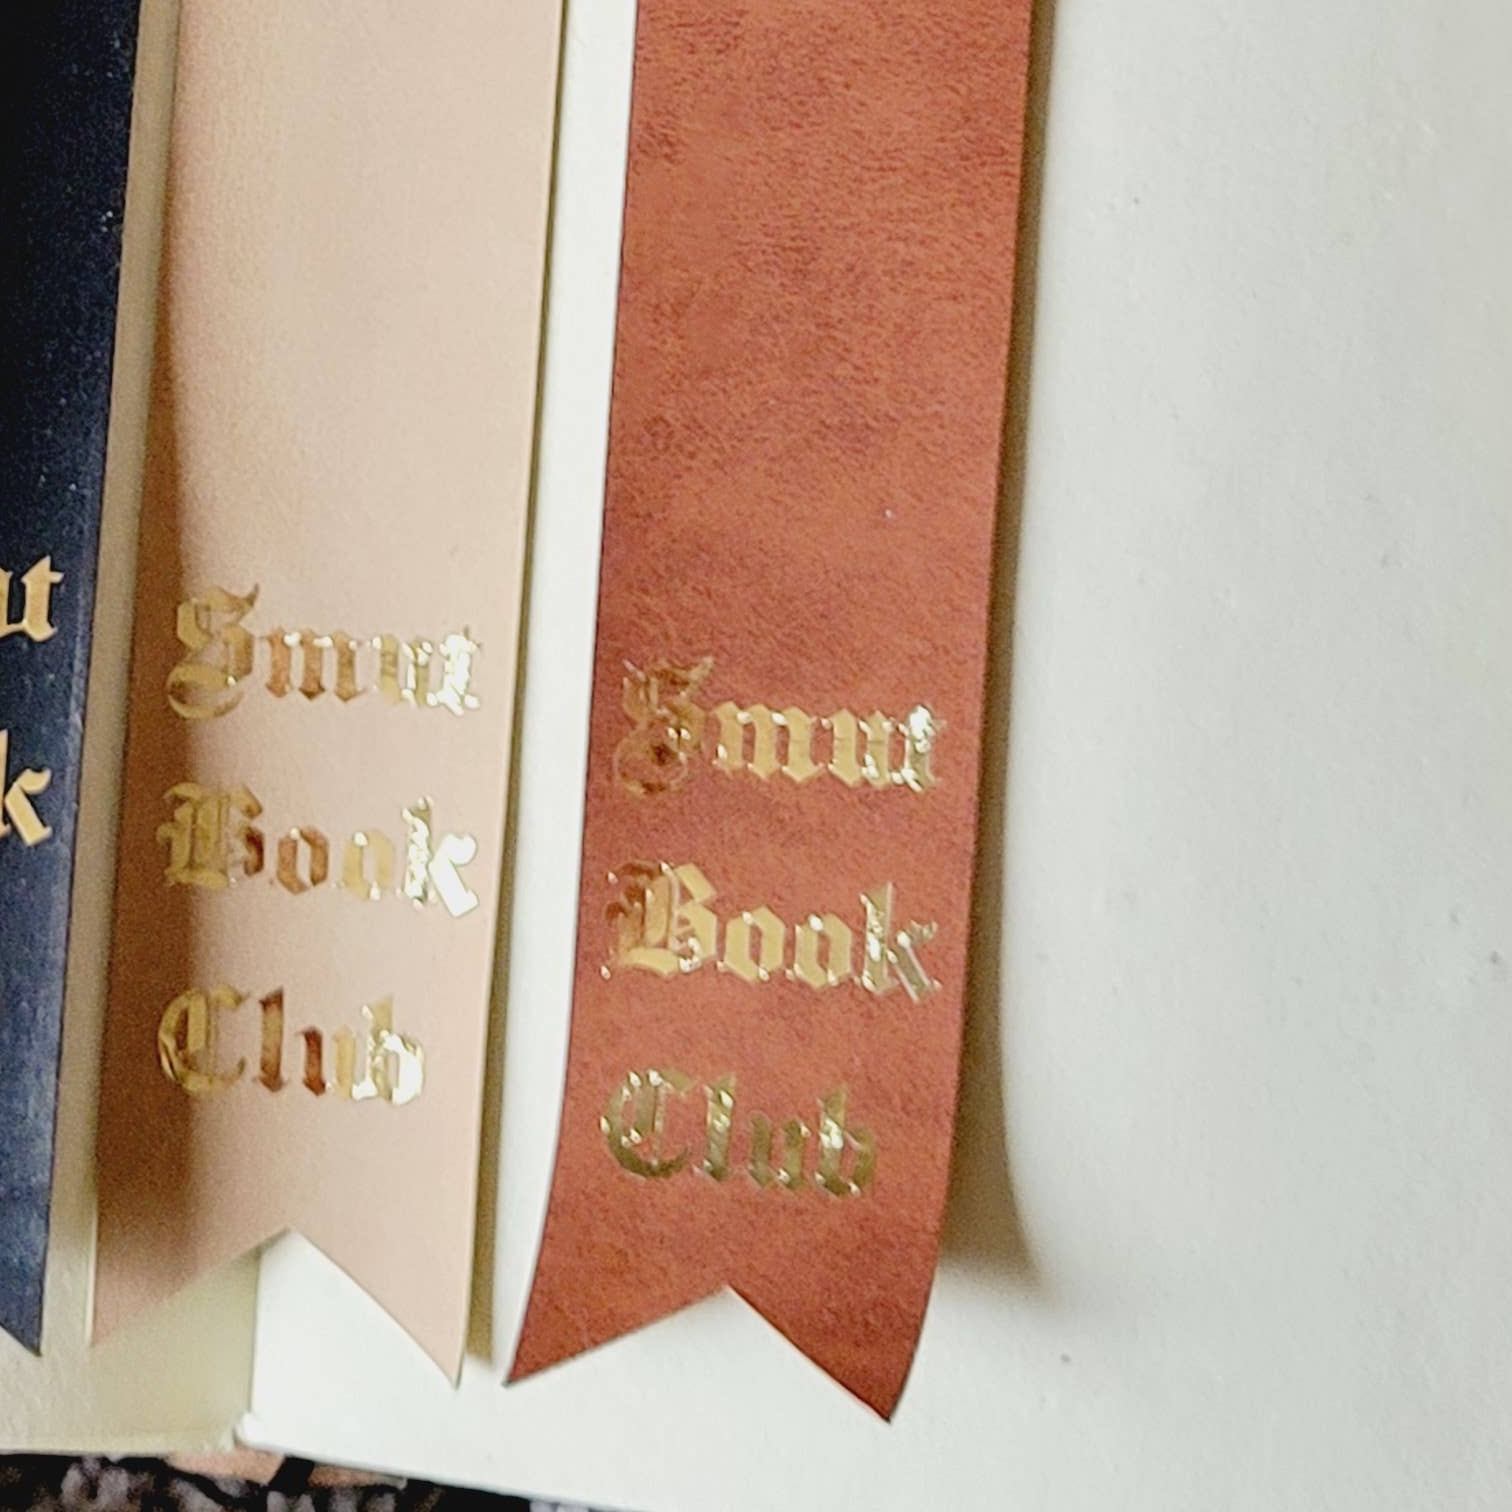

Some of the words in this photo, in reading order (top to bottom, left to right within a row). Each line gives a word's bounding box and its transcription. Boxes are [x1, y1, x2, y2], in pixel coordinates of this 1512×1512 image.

[166, 584, 482, 719] Smut
[613, 656, 944, 796] Smut
[156, 782, 479, 918] Book
[599, 861, 942, 1003] Book
[157, 985, 425, 1106] Club
[600, 1068, 876, 1197] Club
